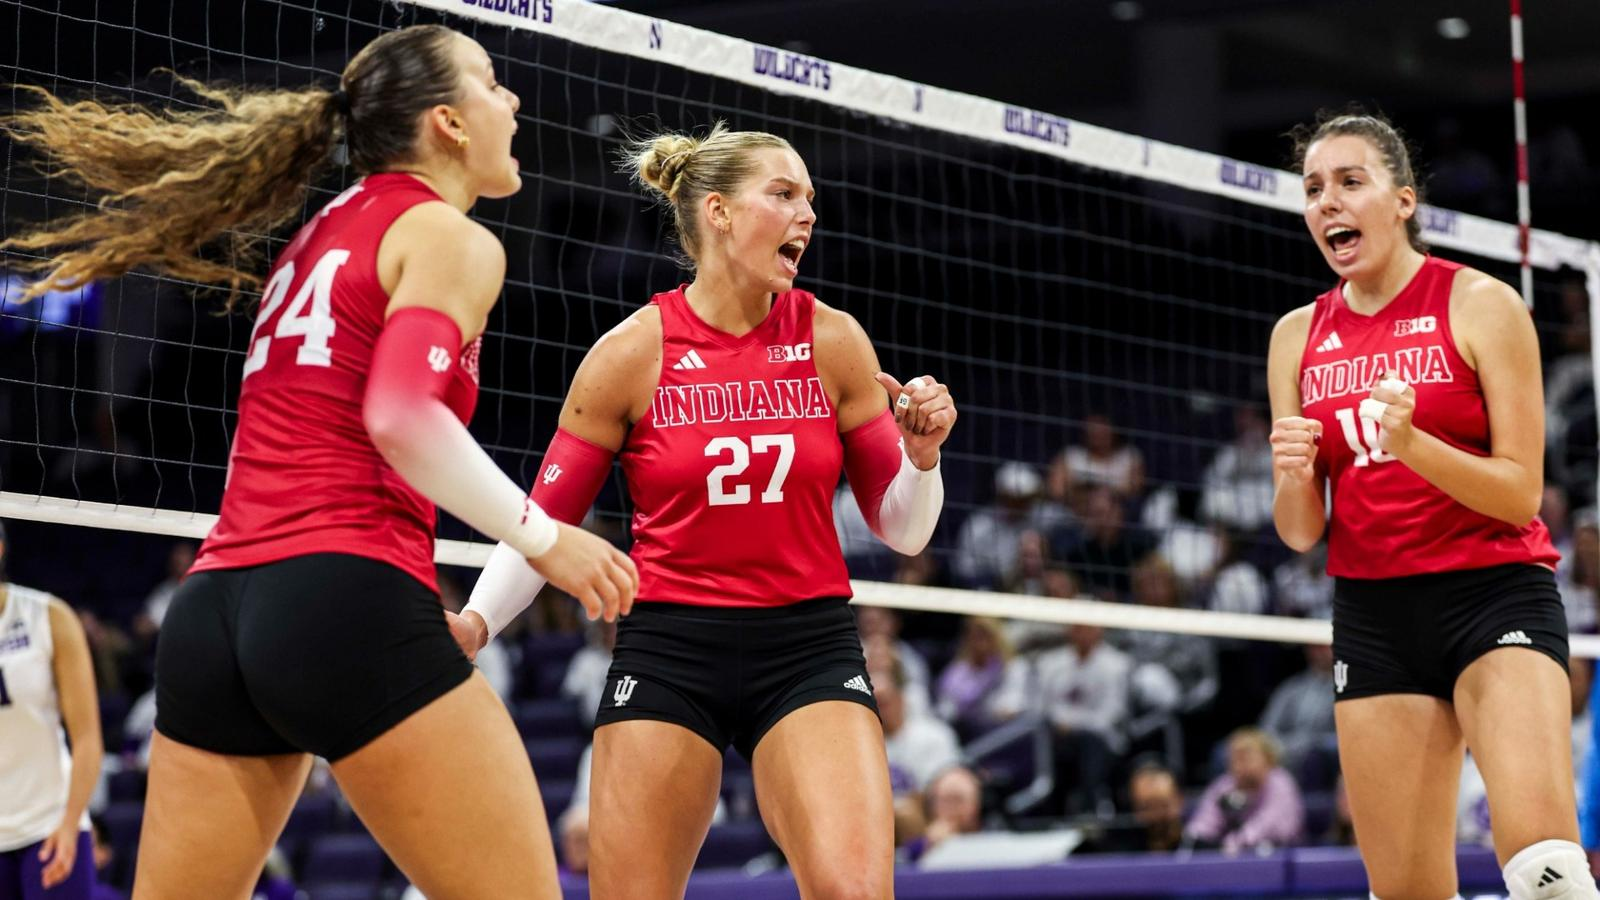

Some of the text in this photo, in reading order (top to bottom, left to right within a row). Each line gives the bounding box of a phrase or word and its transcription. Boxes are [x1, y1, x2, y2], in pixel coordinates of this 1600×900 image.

[462, 0, 552, 23] CATS
[754, 47, 831, 90] WILDCATS
[243, 249, 350, 379] 24
[652, 377, 830, 428] INDIANA
[704, 434, 796, 506] 27
